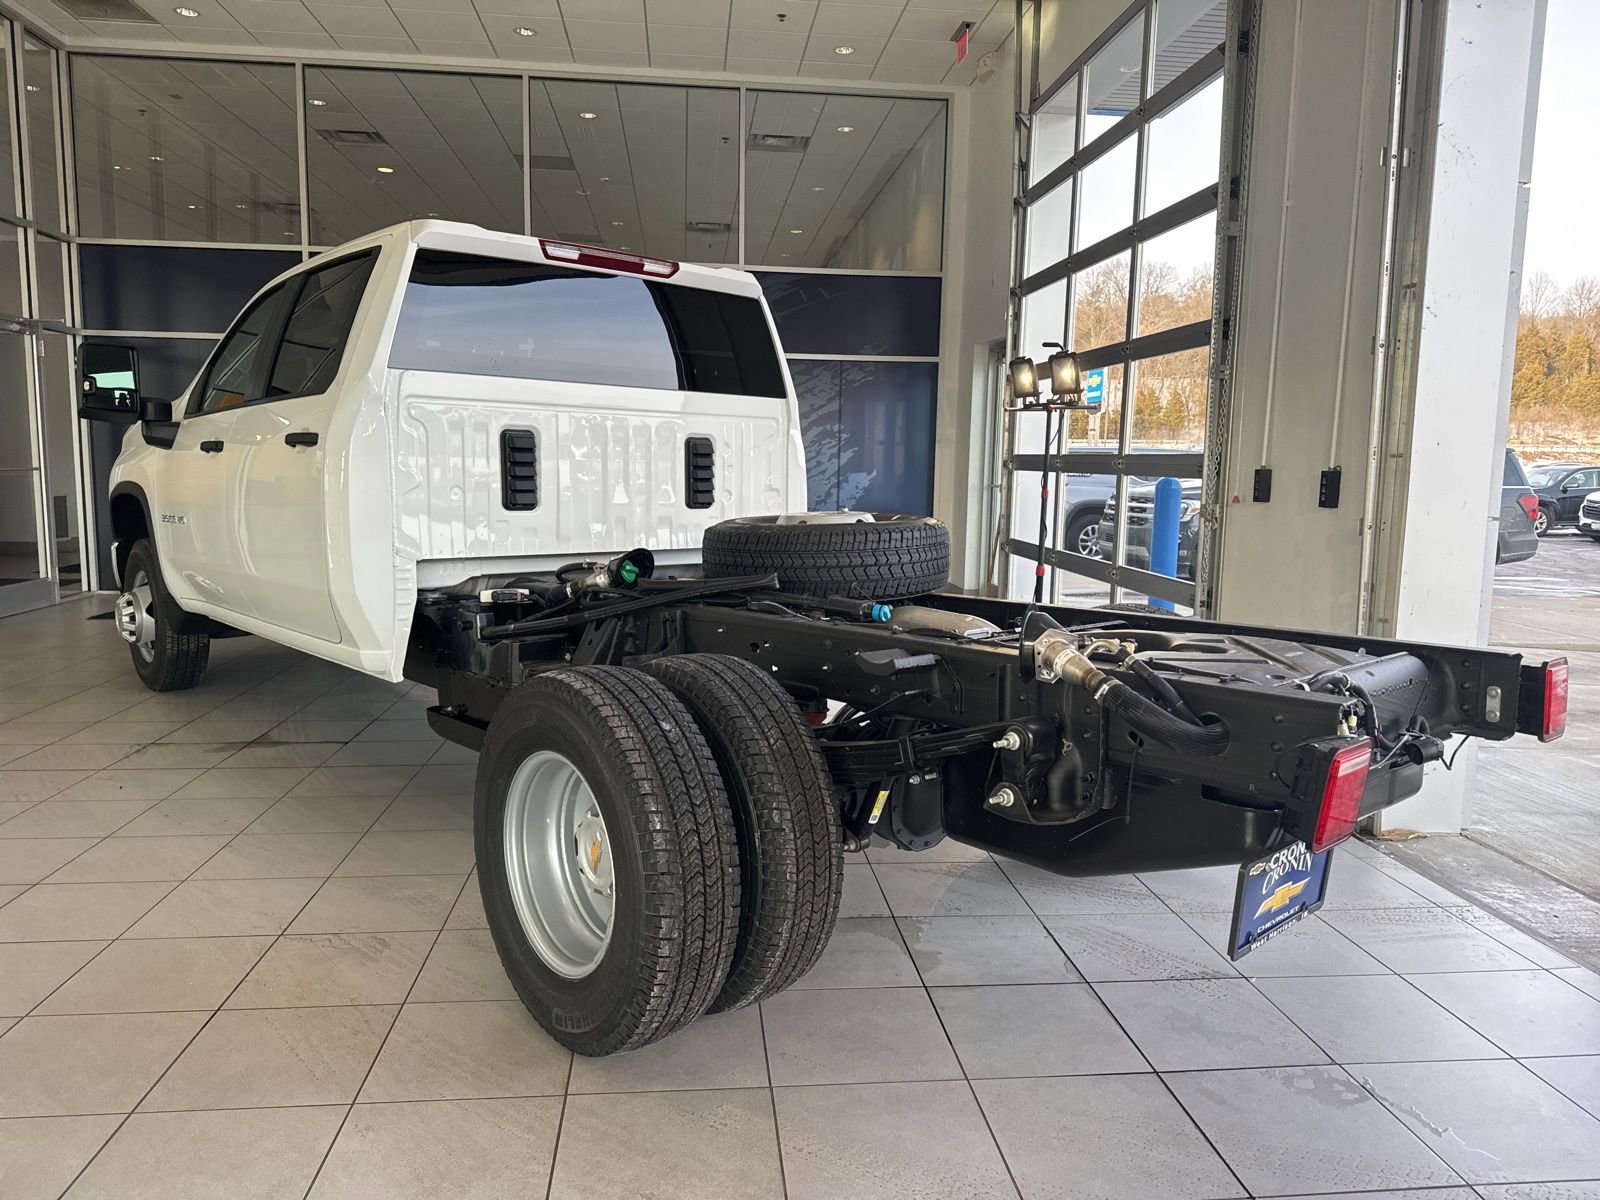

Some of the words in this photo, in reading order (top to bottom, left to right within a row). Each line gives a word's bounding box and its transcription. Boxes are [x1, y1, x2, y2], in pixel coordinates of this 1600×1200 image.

[1271, 842, 1306, 868] CRON
[1262, 852, 1313, 895] CRONIN
[1257, 905, 1300, 933] CHEVROLET
[1250, 936, 1268, 951] West
